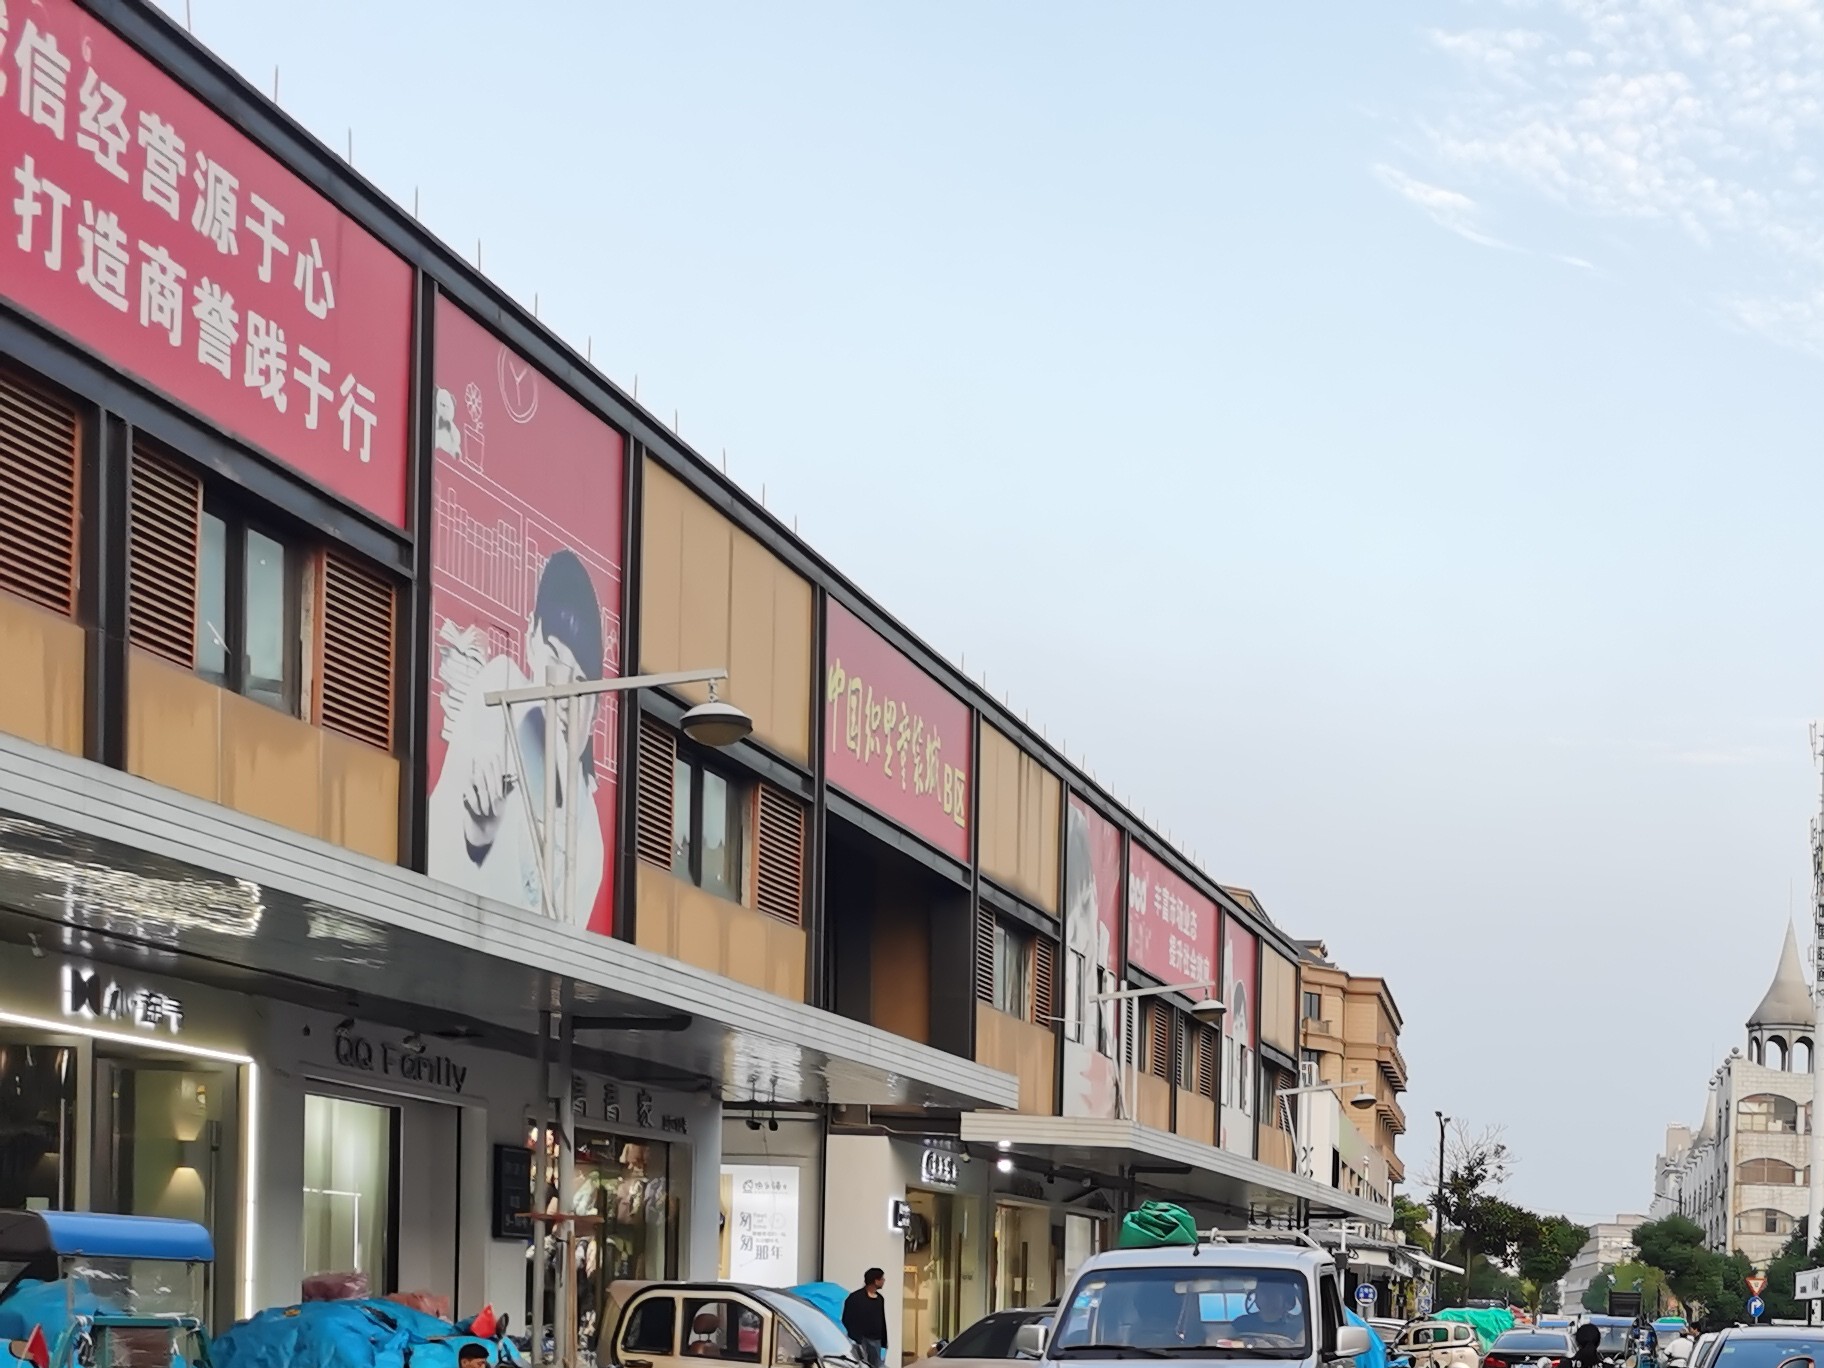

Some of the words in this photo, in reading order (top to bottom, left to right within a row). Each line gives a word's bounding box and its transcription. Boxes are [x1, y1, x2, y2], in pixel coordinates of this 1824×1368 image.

[13, 154, 378, 463] 打造商誉践于行
